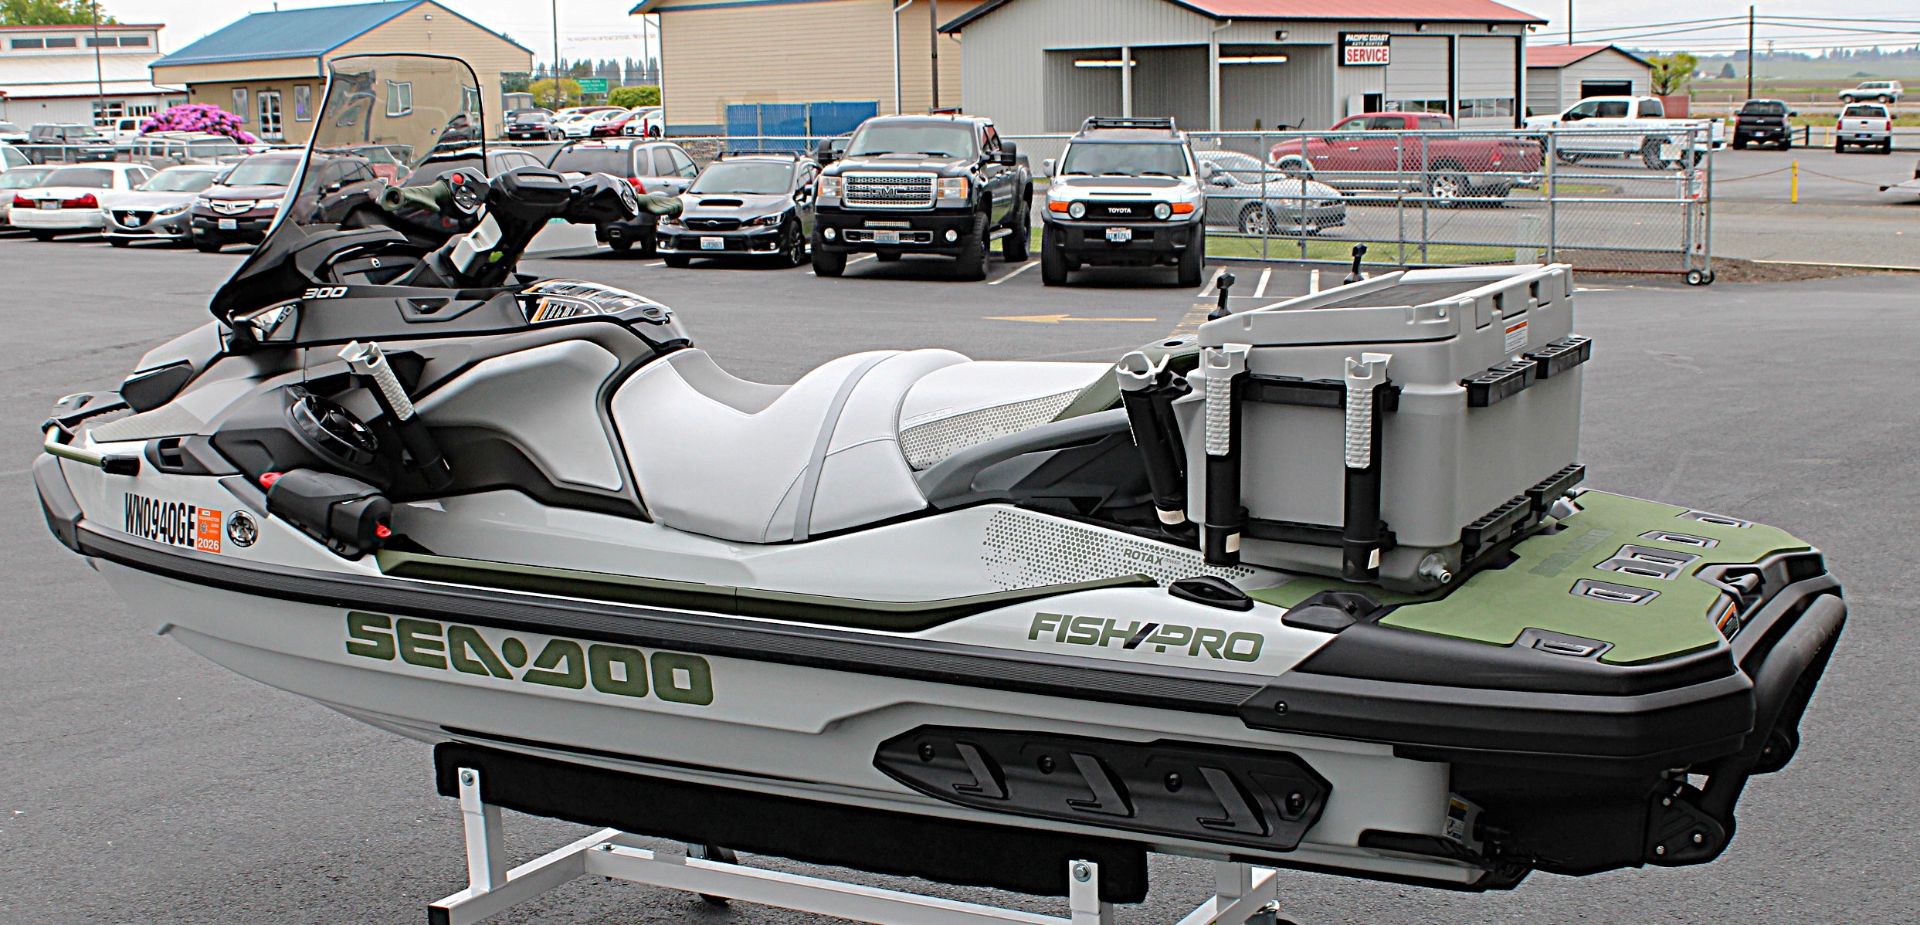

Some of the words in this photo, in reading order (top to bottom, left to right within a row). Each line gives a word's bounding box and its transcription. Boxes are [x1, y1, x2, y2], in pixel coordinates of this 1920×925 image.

[1347, 49, 1387, 62] SERVICE
[302, 286, 348, 299] 300
[125, 492, 196, 548] WN0940GE
[198, 538, 220, 550] 2026
[1123, 548, 1164, 566] ROTAX
